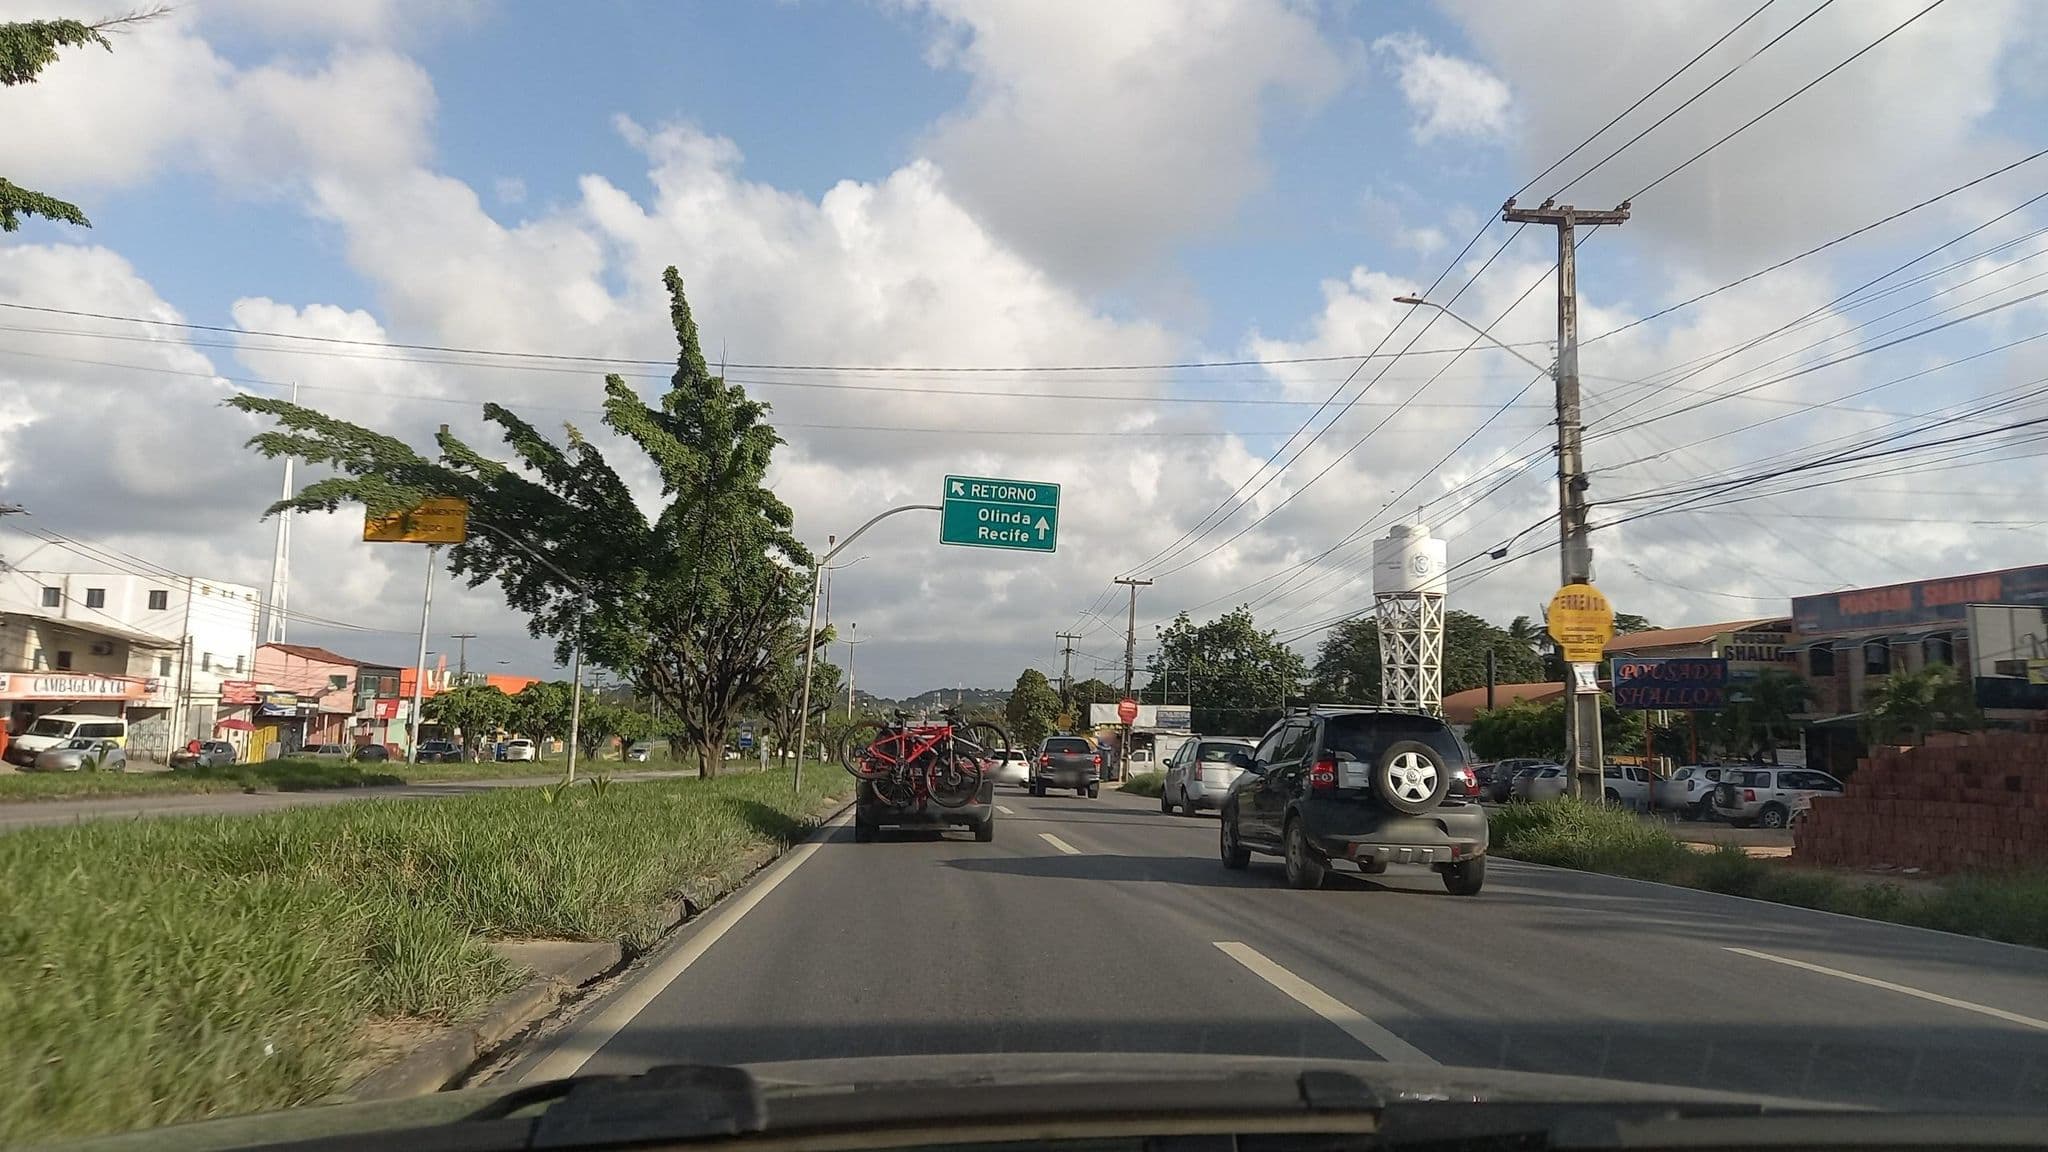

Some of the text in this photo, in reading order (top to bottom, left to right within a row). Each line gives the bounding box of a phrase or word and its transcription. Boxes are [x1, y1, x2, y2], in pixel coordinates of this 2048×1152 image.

[971, 484, 1037, 502] RETORNO
[978, 508, 1031, 525] Olinda
[978, 526, 1030, 542] Recife
[1618, 662, 1723, 681] POUSADA
